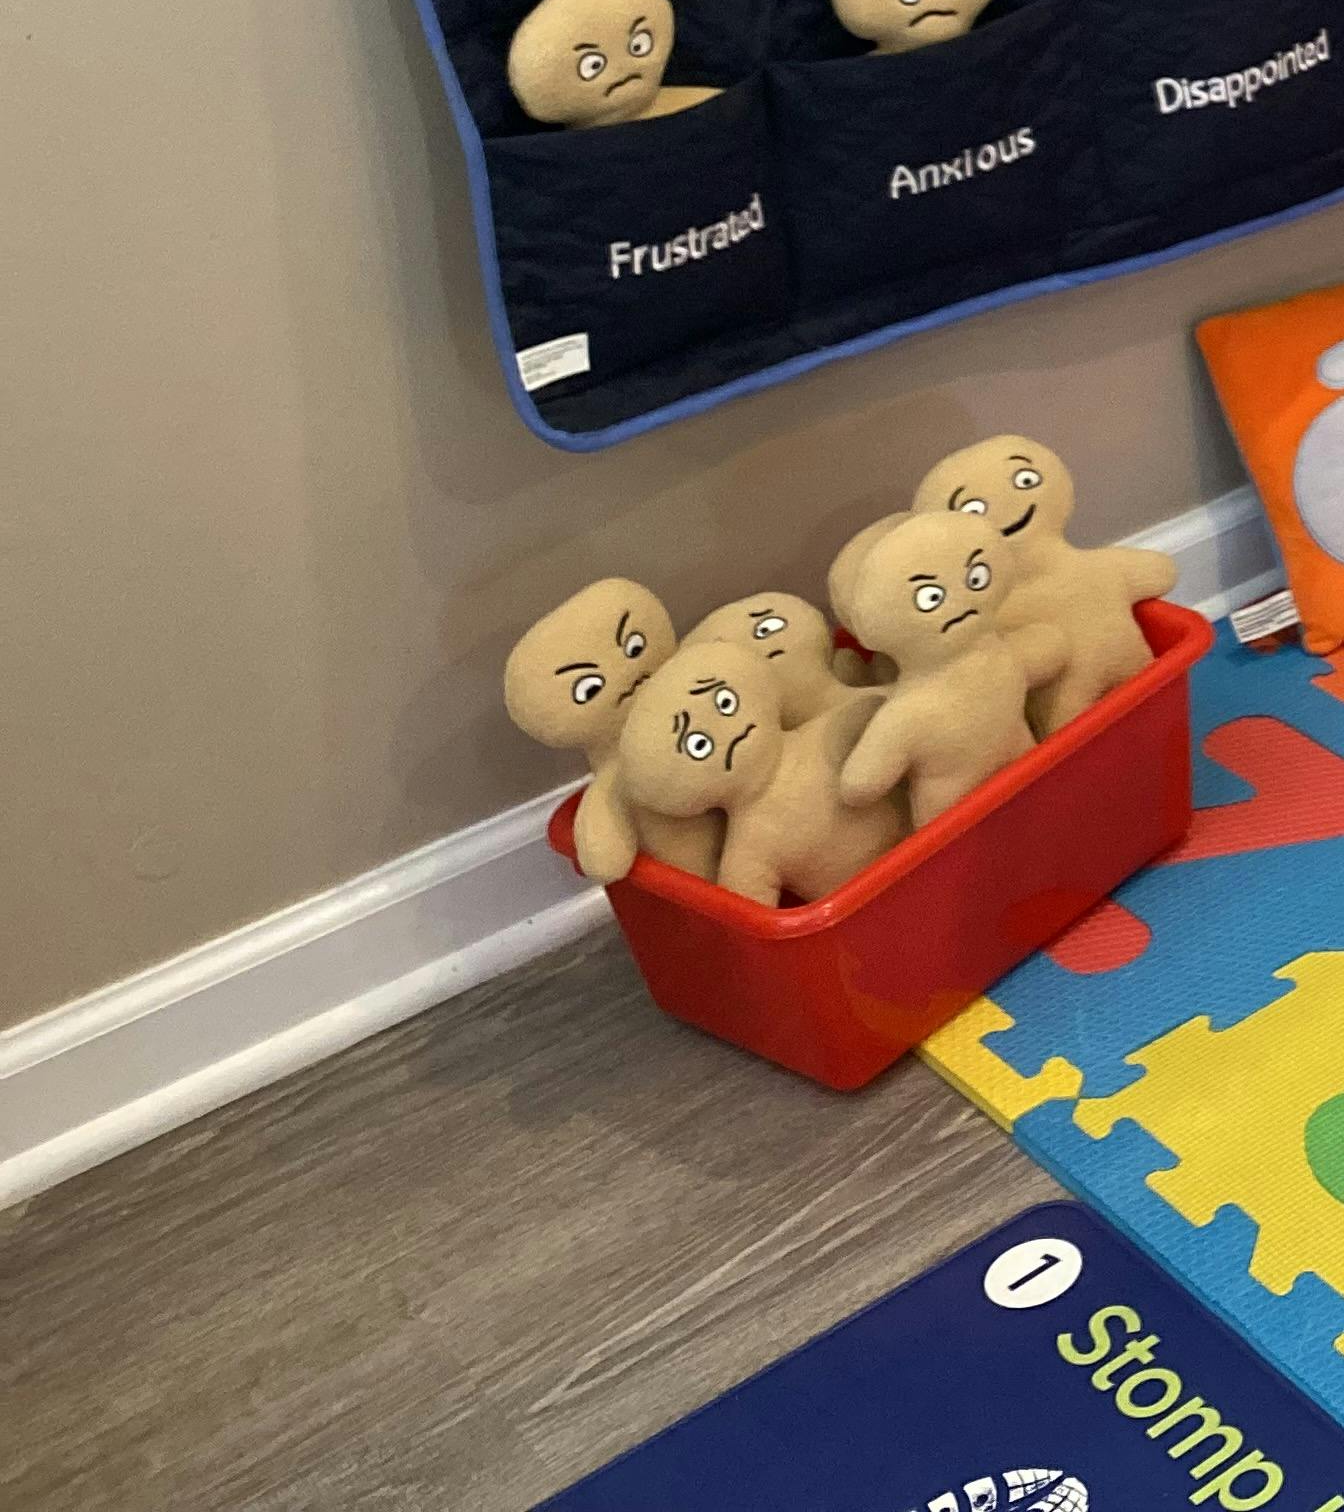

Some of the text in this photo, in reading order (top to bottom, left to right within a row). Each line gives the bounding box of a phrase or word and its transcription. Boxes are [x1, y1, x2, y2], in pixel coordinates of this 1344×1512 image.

[1154, 28, 1332, 115] Disappointed
[889, 127, 1037, 199] Anxious
[608, 193, 767, 280] Frustrated
[1007, 1253, 1062, 1292] 1
[1055, 1304, 1285, 1512] Stomp
